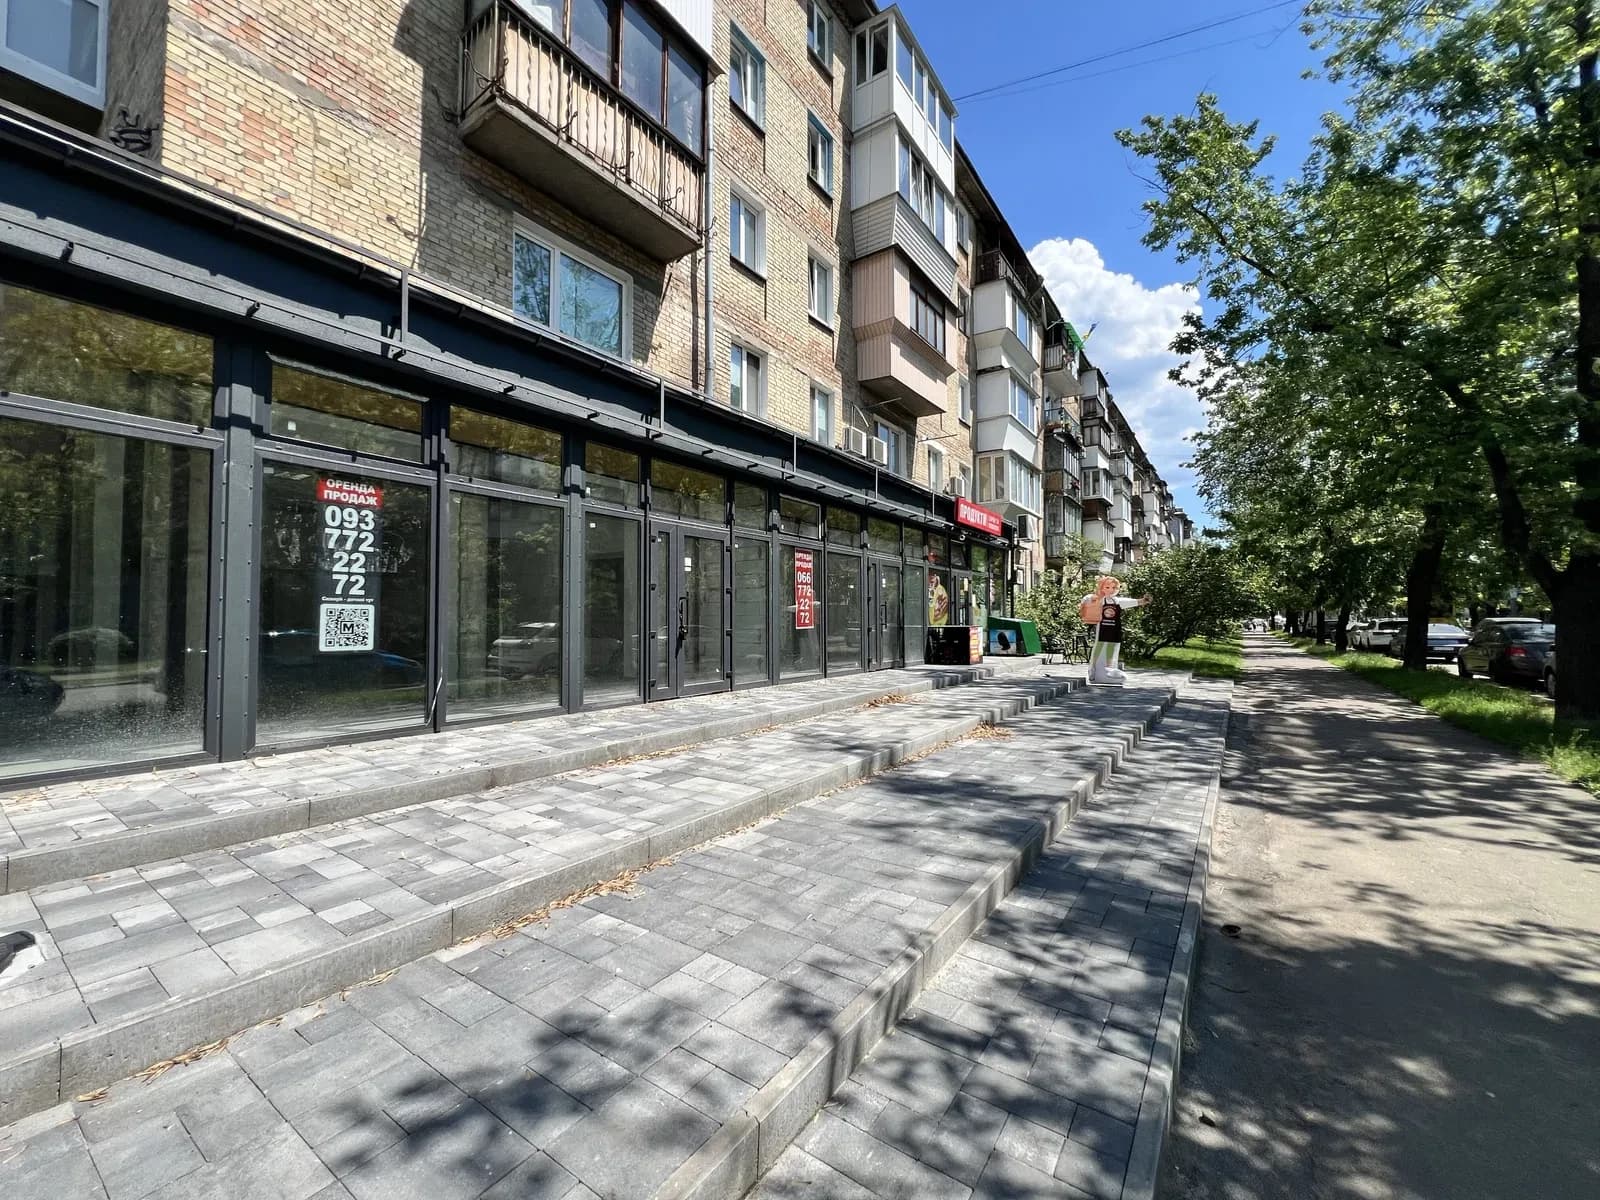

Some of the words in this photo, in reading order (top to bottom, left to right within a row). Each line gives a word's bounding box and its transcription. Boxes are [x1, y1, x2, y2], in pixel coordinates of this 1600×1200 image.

[326, 478, 376, 495] ОРЕНДА
[323, 489, 378, 506] ПРОДАЖ
[324, 505, 376, 531] 093
[324, 527, 375, 552] 772
[332, 551, 366, 574] 22
[332, 574, 366, 596] 72
[797, 571, 811, 584] 066
[797, 584, 812, 596] 772
[799, 598, 810, 610] 22
[799, 612, 810, 624] 72
